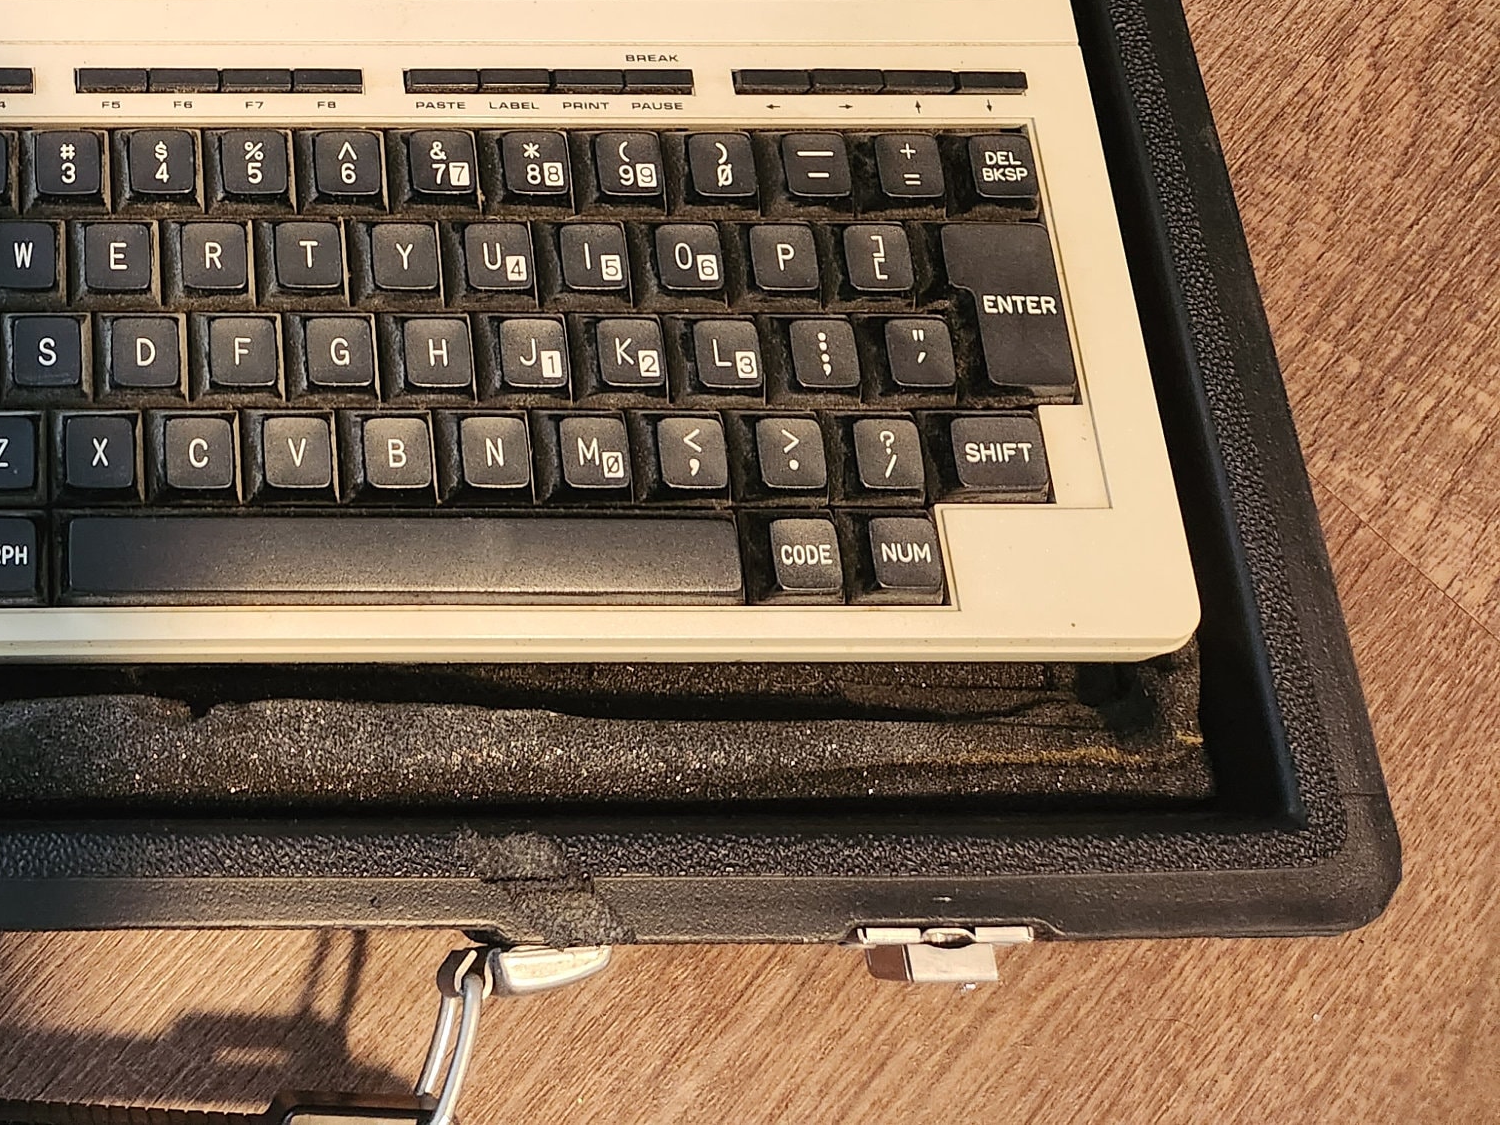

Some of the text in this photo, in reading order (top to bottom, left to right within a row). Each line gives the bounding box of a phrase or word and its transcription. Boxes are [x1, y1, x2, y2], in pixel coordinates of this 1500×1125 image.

[625, 54, 678, 62] BREAK
[101, 101, 121, 109] F5
[173, 100, 193, 109] F6
[245, 101, 264, 109] F7
[317, 101, 337, 109] F8
[415, 101, 466, 110] PASTE
[489, 101, 540, 110] LABEL
[562, 101, 609, 110] PRINT
[631, 102, 683, 110] PAUSE
[60, 143, 76, 160] #
[154, 140, 168, 162] $
[244, 141, 264, 161] %
[429, 141, 447, 160] &
[618, 141, 630, 163] (
[715, 142, 728, 164] )
[899, 143, 916, 160] +
[984, 151, 1022, 166] DEL
[61, 162, 76, 184] 3
[155, 163, 170, 183] 4
[247, 163, 263, 184] 5
[341, 163, 356, 184] 6
[431, 163, 446, 185] 7
[526, 163, 542, 185] 8
[618, 164, 635, 186] 9
[903, 173, 921, 185] =
[982, 167, 1028, 182] BKSP
[14, 242, 33, 268] W
[109, 242, 128, 270] E
[204, 241, 222, 269] R
[299, 240, 319, 268] T
[395, 243, 413, 270] Y
[482, 242, 502, 271] U
[776, 243, 795, 271] P
[870, 235, 885, 258] ]
[873, 257, 888, 280] [
[982, 295, 1057, 315] ENTER
[38, 337, 57, 366] S
[136, 337, 156, 366] D
[234, 337, 252, 365] F
[330, 337, 350, 366] G
[428, 338, 448, 367] H
[519, 337, 537, 366] J
[615, 337, 635, 366] K
[712, 338, 733, 367] L
[577, 437, 600, 466] M
[683, 428, 702, 453] <
[781, 428, 800, 454] >
[879, 430, 895, 455] ?
[92, 437, 109, 467] X
[188, 438, 209, 468] C
[287, 437, 307, 467] V
[387, 438, 407, 468] B
[485, 437, 505, 467] N
[965, 442, 1032, 463] SHIFT
[885, 454, 897, 479] /
[780, 544, 833, 566] CODE
[881, 542, 932, 564] NUM
